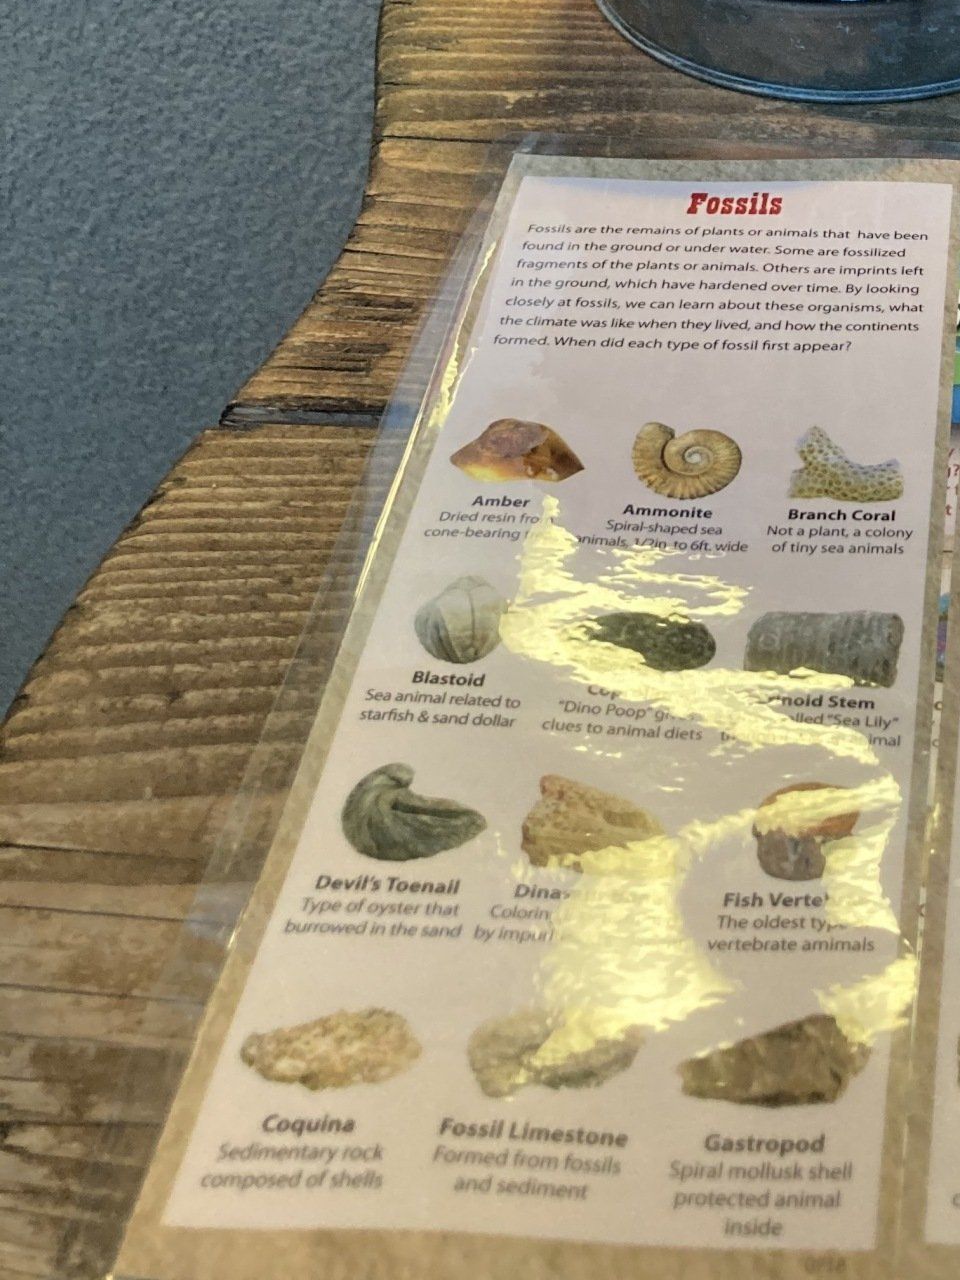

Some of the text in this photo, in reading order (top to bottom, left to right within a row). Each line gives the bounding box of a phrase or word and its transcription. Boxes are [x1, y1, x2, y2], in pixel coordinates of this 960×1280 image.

[686, 191, 782, 214] Fossils
[527, 223, 571, 233] Fossils
[600, 224, 623, 233] the
[626, 226, 680, 235] remains
[684, 226, 700, 235] of
[702, 227, 744, 237] plants
[765, 228, 818, 237] animals
[822, 228, 850, 239] that
[857, 229, 890, 239] have
[893, 230, 928, 240] been
[522, 240, 905, 257] found in the ground or under water. Some are fossilized
[516, 258, 587, 270] fragments
[591, 258, 608, 269] of
[609, 259, 633, 269] the
[635, 259, 679, 271] plants
[701, 261, 758, 271] animals.
[762, 262, 809, 273] Others
[813, 266, 835, 274] are
[839, 265, 897, 277] imprints
[901, 265, 924, 276] left
[528, 277, 551, 287] the
[554, 278, 610, 289] ground,
[615, 278, 657, 288] which
[661, 279, 695, 289] have
[698, 279, 767, 291] hardened
[770, 283, 803, 292] over
[806, 282, 841, 293] time.
[845, 283, 862, 295] By
[866, 283, 919, 296] looking
[505, 295, 924, 315] closely at fossils, we can learn about these organisms, what
[499, 314, 919, 332] the climate was like when they lived, and how the continents
[493, 334, 852, 353] formed. When did each type of fossil first appear?
[471, 495, 530, 507] Amber
[622, 503, 712, 518] Ammonite
[787, 508, 895, 521] Branch Coral
[766, 525, 913, 540] Not a plant, a colony
[771, 540, 904, 556] of tiny sea animals
[411, 670, 485, 687] Blastoid
[314, 874, 460, 894] Devil's Toenail
[261, 1113, 355, 1137] Coquina
[438, 1116, 628, 1148] Fossil Limestone
[703, 1133, 825, 1157] Gastropod
